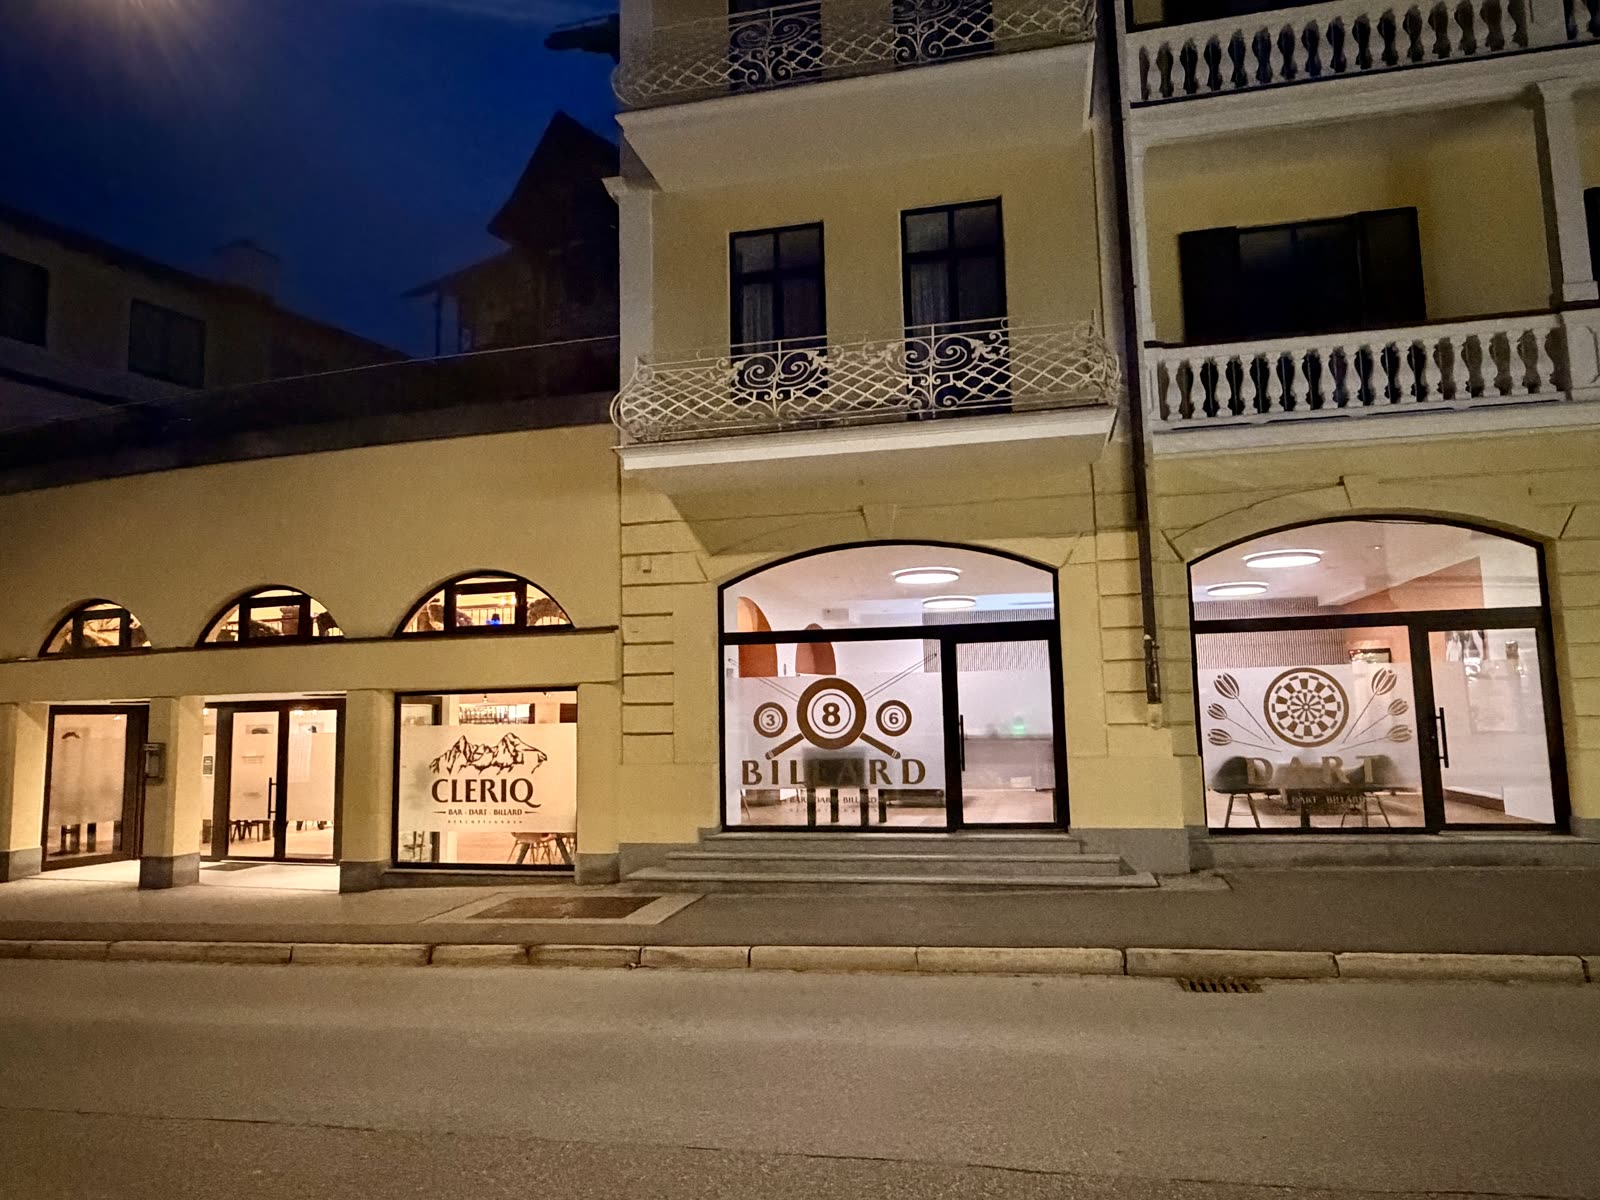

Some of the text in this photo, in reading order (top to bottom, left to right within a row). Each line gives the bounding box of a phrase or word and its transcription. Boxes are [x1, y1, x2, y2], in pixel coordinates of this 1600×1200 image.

[766, 714, 776, 727] 3
[821, 702, 841, 727] 8
[888, 712, 899, 725] 6
[1246, 755, 1381, 785] DART
[431, 777, 541, 808] CLERIQ
[842, 796, 877, 804] BILLD
[448, 808, 523, 816] BAR DART BILLARD
